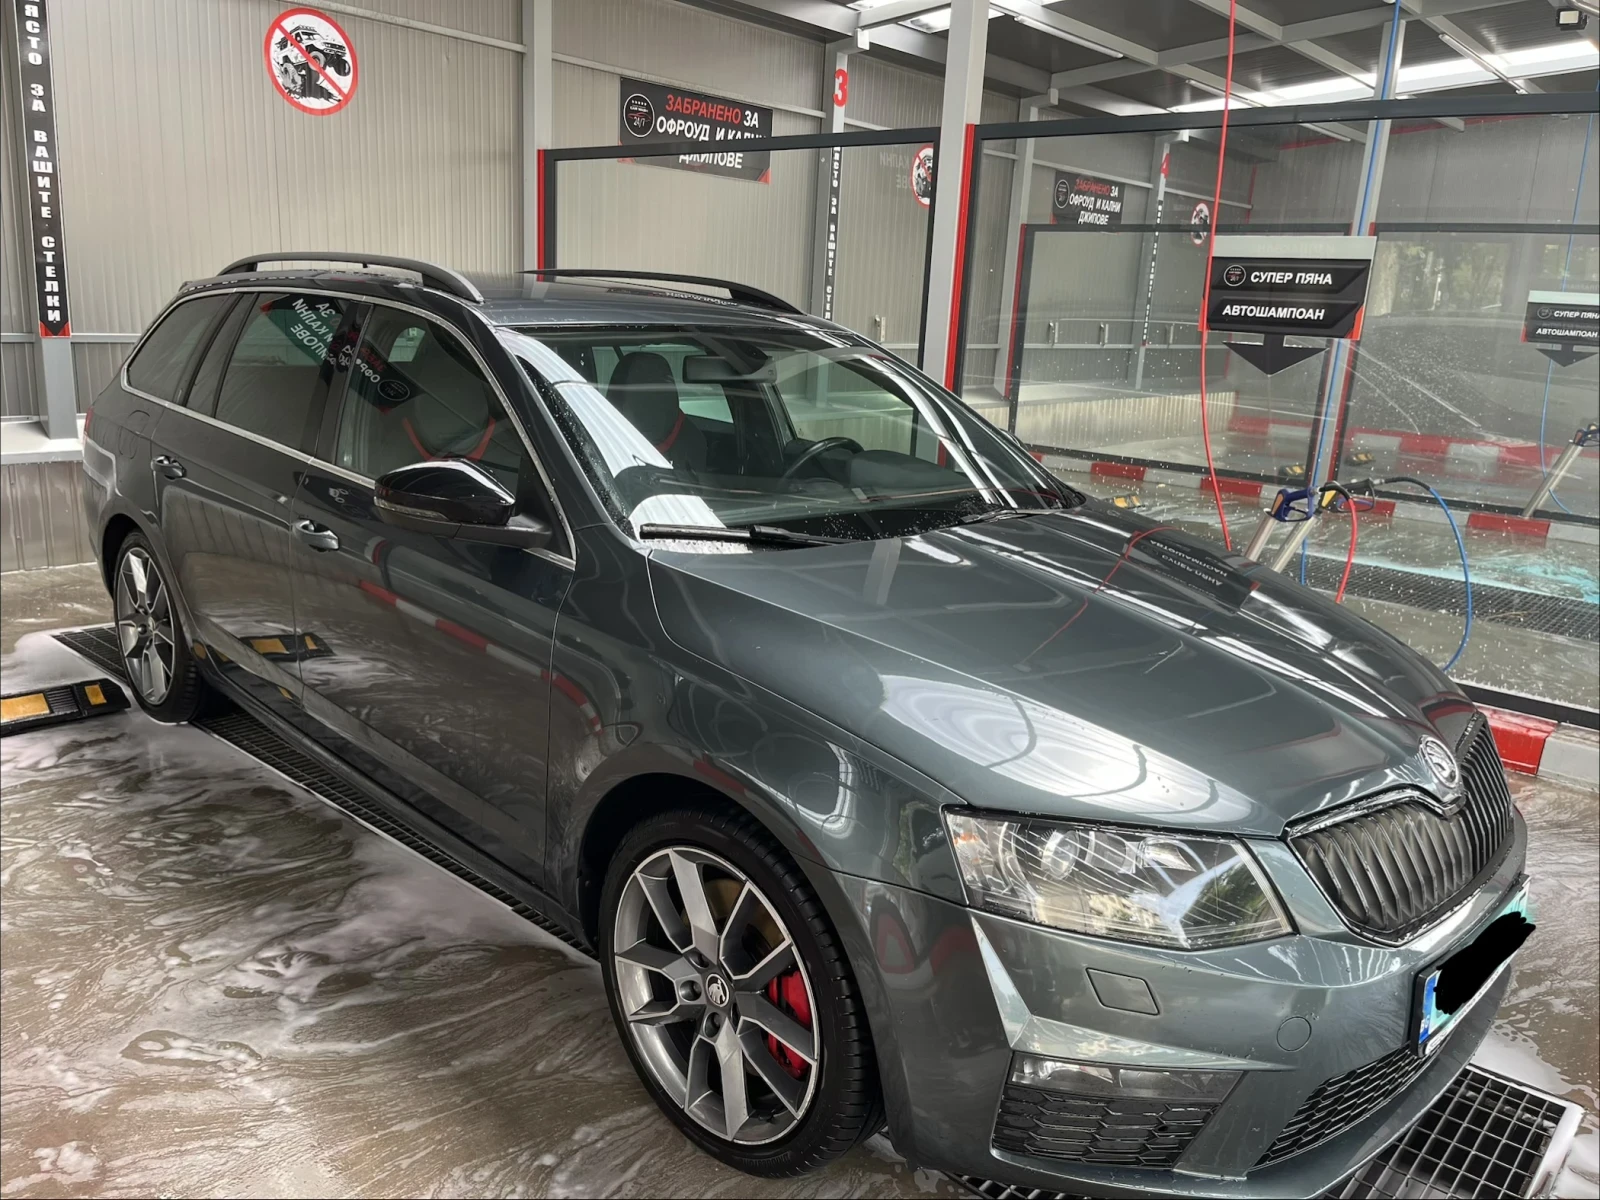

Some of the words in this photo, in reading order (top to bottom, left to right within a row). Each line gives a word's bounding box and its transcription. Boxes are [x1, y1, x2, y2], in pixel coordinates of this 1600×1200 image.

[25, 0, 42, 65] ЯСТО
[30, 84, 46, 112] ЗА
[832, 68, 848, 107] 3
[665, 95, 742, 124] ЗАБРАНЕНО
[743, 110, 759, 129] ЗА
[656, 116, 710, 141] ОФРОУД
[715, 126, 726, 141] И
[32, 130, 53, 218] ВАШИТЕ
[1070, 193, 1095, 211] ОФРОУД
[1110, 185, 1119, 198] ЗА
[41, 236, 61, 322] СТЕЛКИ
[1250, 271, 1293, 284] СУПЕР
[1295, 272, 1332, 285] ПЯНА
[1222, 304, 1325, 320] АВТОШАМПОАН
[1554, 310, 1580, 319] СУПЕР
[1536, 328, 1598, 338] АВТОШАМПОАН
